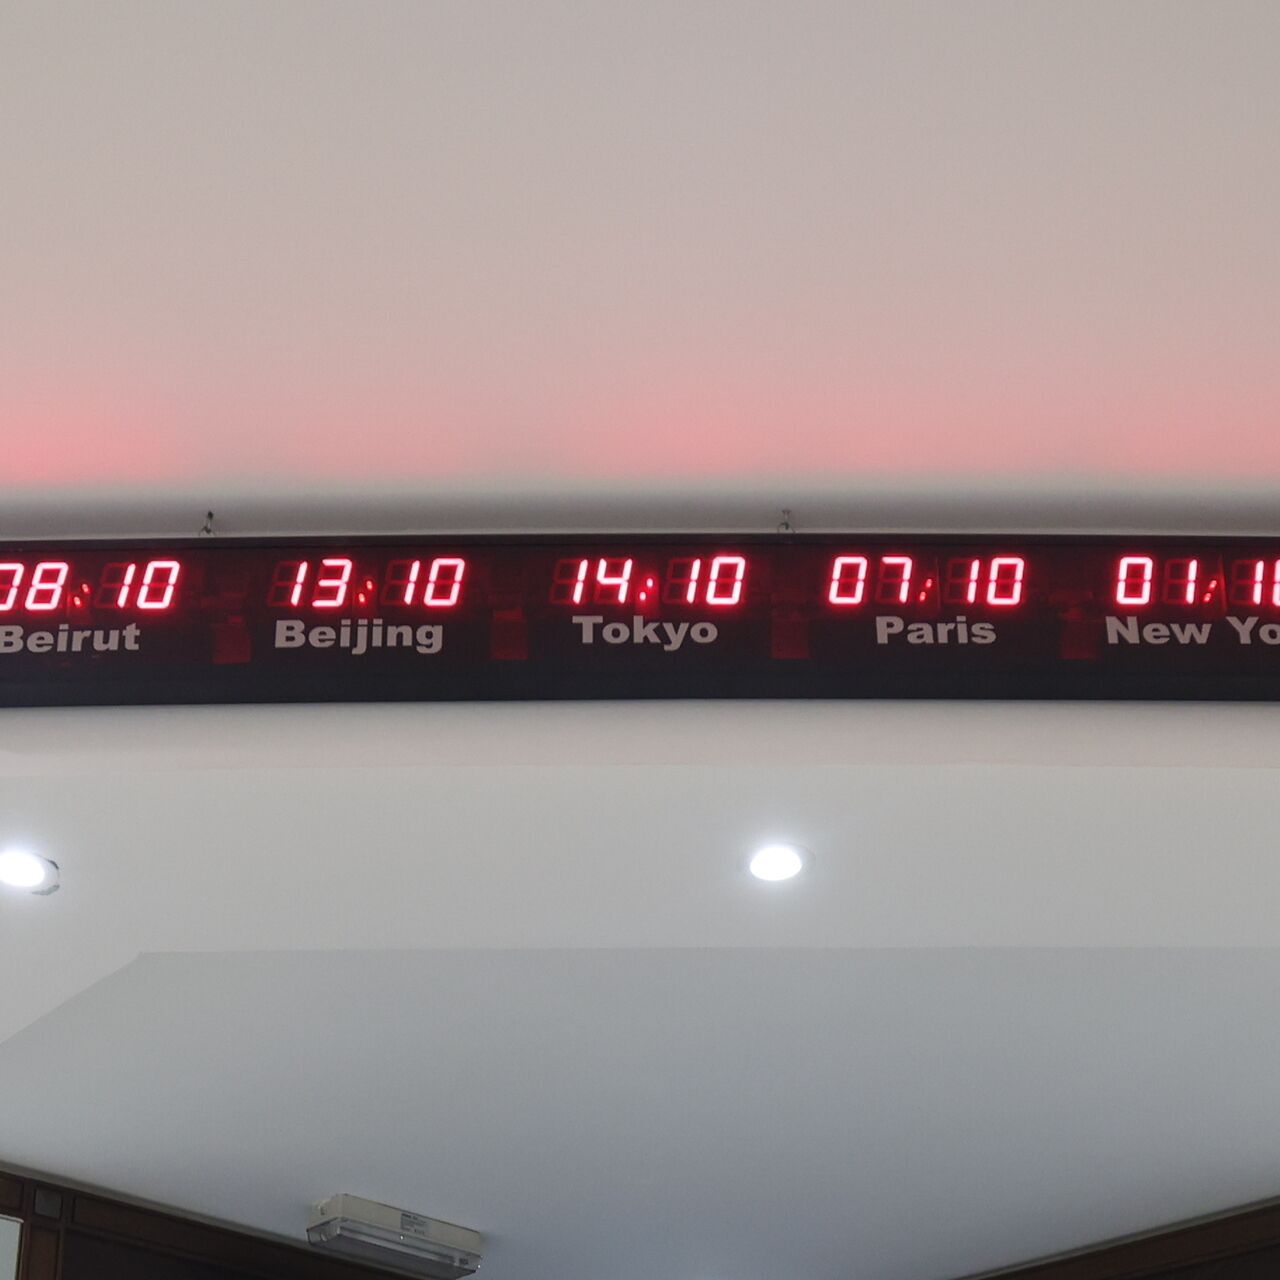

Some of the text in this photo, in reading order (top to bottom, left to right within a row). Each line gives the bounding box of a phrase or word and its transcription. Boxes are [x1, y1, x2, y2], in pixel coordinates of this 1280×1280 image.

[290, 558, 466, 607] 13:10
[573, 556, 746, 605] 14:10
[828, 556, 1025, 605] 07:10
[274, 618, 443, 655] Beijing
[572, 615, 719, 651] Tokyo
[875, 615, 997, 644] Paris
[1105, 615, 1212, 644] New
